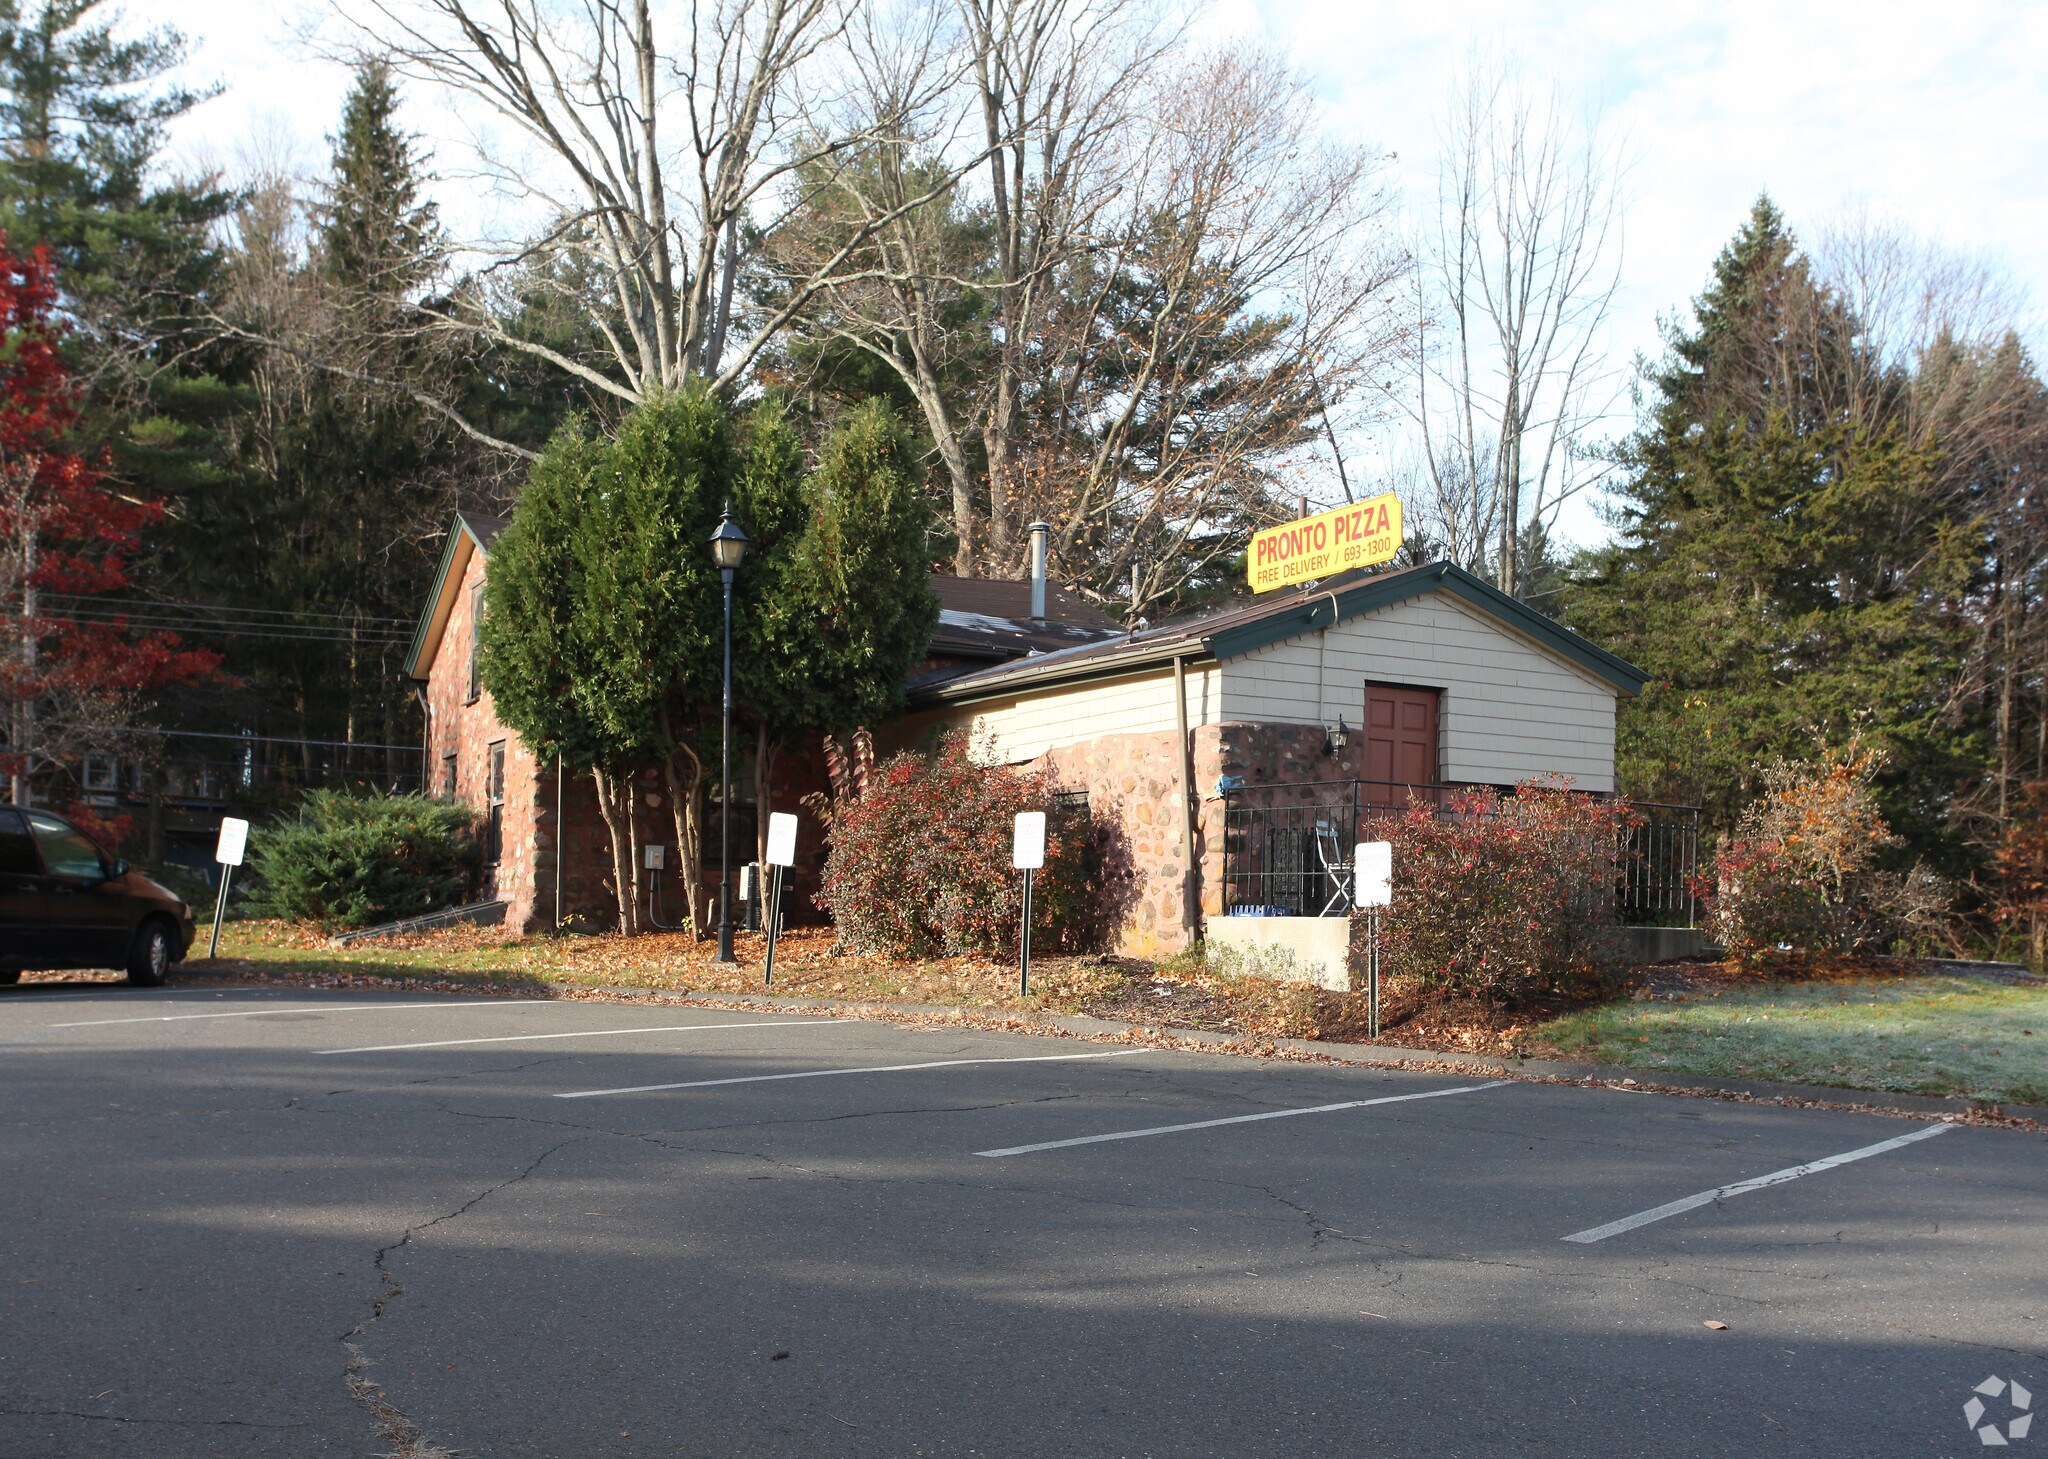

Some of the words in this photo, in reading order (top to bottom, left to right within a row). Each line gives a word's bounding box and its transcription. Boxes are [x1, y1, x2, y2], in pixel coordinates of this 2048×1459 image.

[1257, 521, 1327, 567] PRONTO
[1334, 503, 1391, 546] PIZZA
[1257, 567, 1279, 585] FREE
[1283, 552, 1330, 578] DELIVERY
[1335, 550, 1340, 565] /
[1344, 536, 1391, 562] 693-1300
